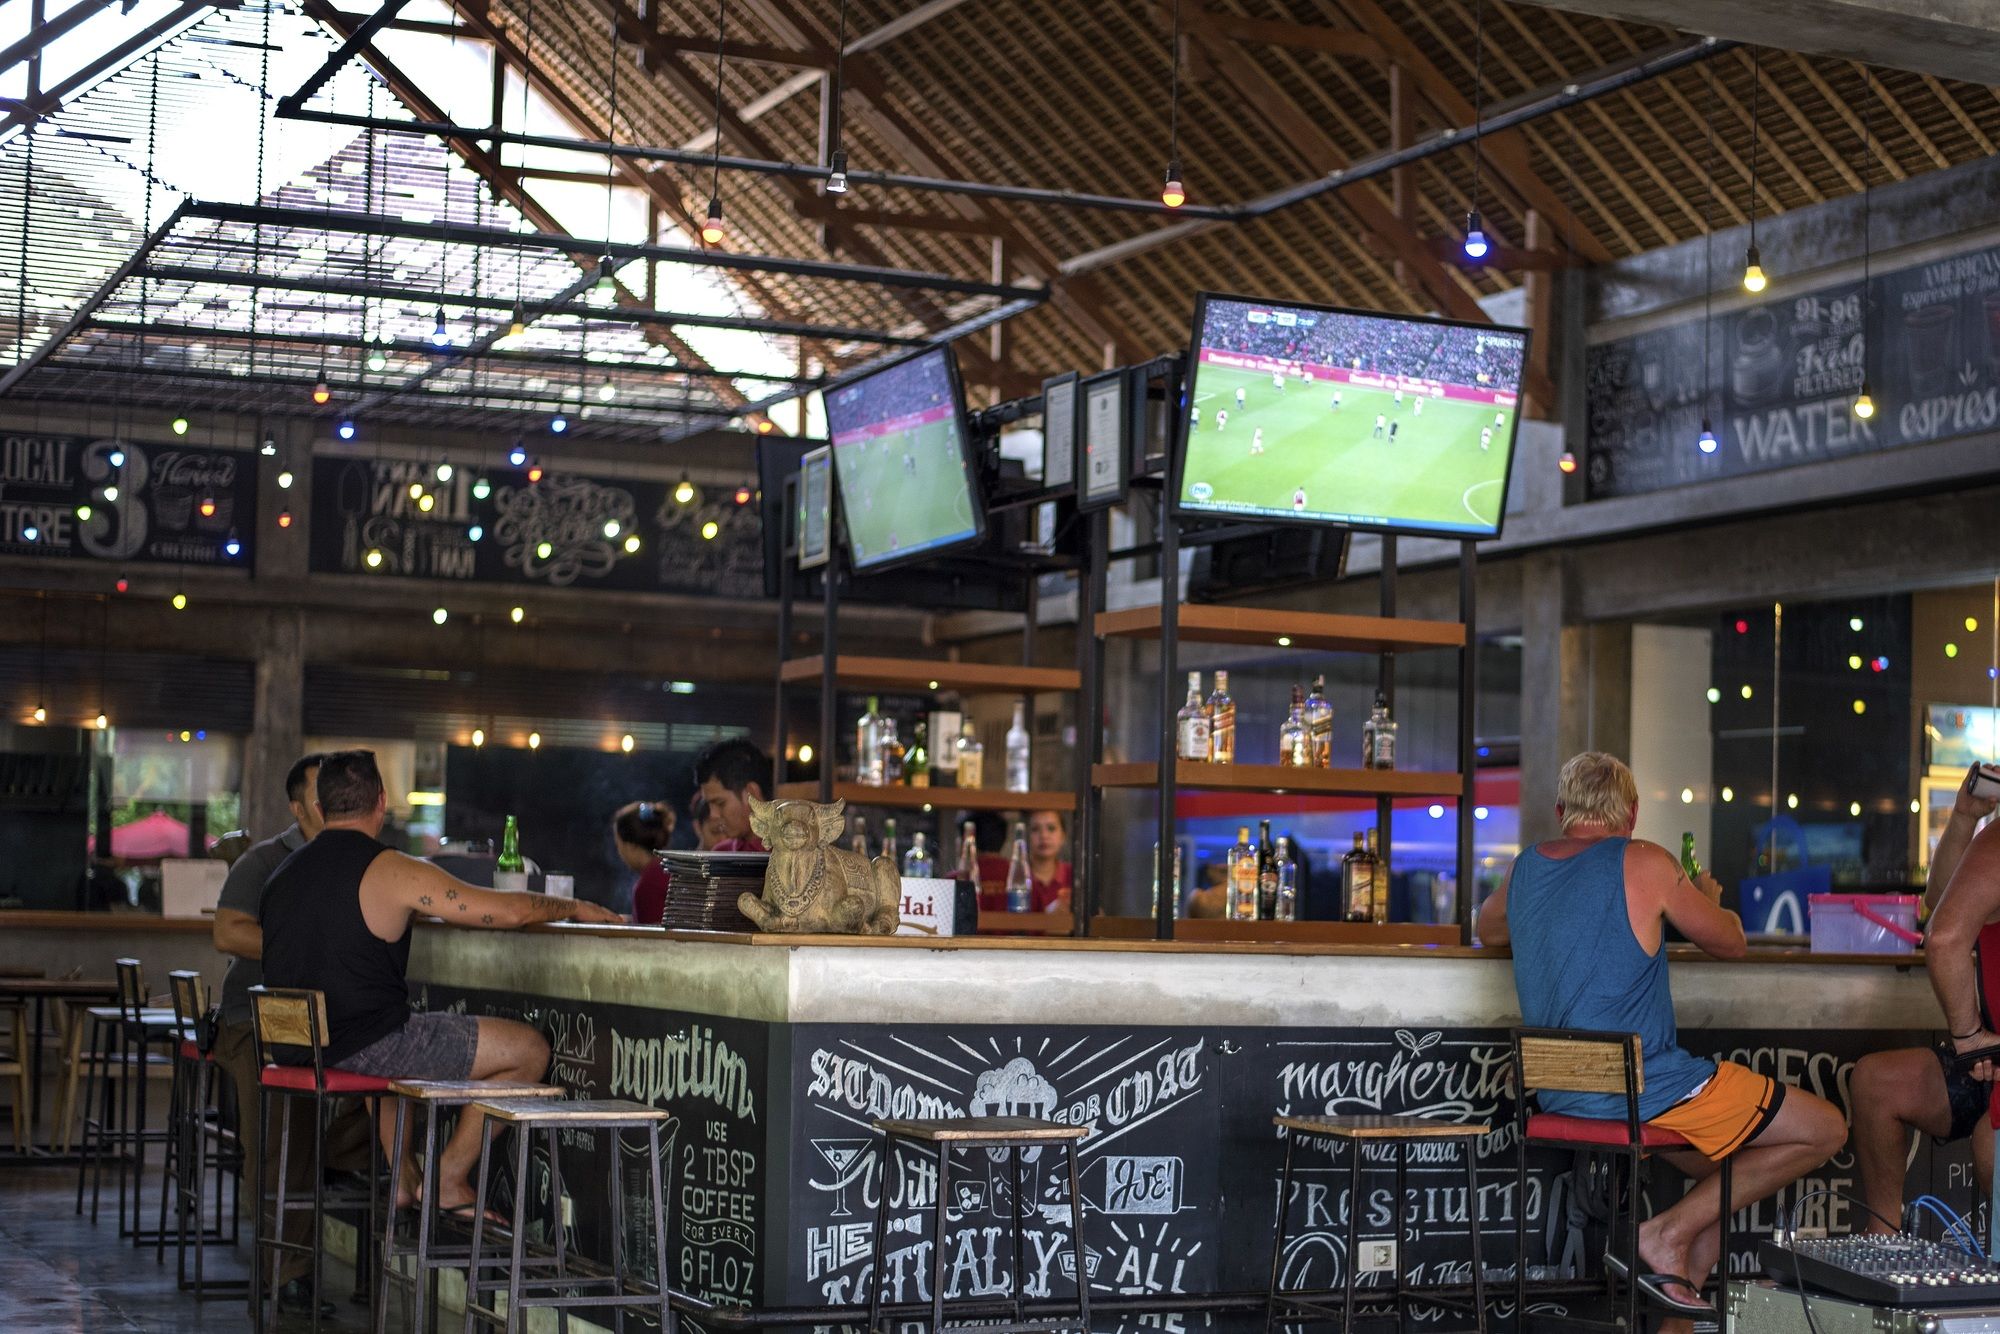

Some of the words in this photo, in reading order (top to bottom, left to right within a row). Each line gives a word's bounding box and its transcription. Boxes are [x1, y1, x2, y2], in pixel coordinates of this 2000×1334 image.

[1734, 398, 1875, 462] WATER
[1899, 386, 2000, 439] espres
[0, 437, 74, 486] OCAL
[79, 439, 149, 558] 3
[549, 1008, 597, 1062] SALSA
[706, 1120, 728, 1143] USE
[1053, 1093, 1102, 1124] FOR
[683, 1144, 695, 1180] 2
[703, 1147, 755, 1188] TBSP
[682, 1185, 755, 1222] COFFEE
[685, 1221, 705, 1240] FOR
[712, 1226, 751, 1246] EVERY
[807, 1222, 873, 1282] HE
[681, 1246, 694, 1283] 6
[1068, 1254, 1093, 1274] HS
[1115, 1246, 1187, 1294] ALL
